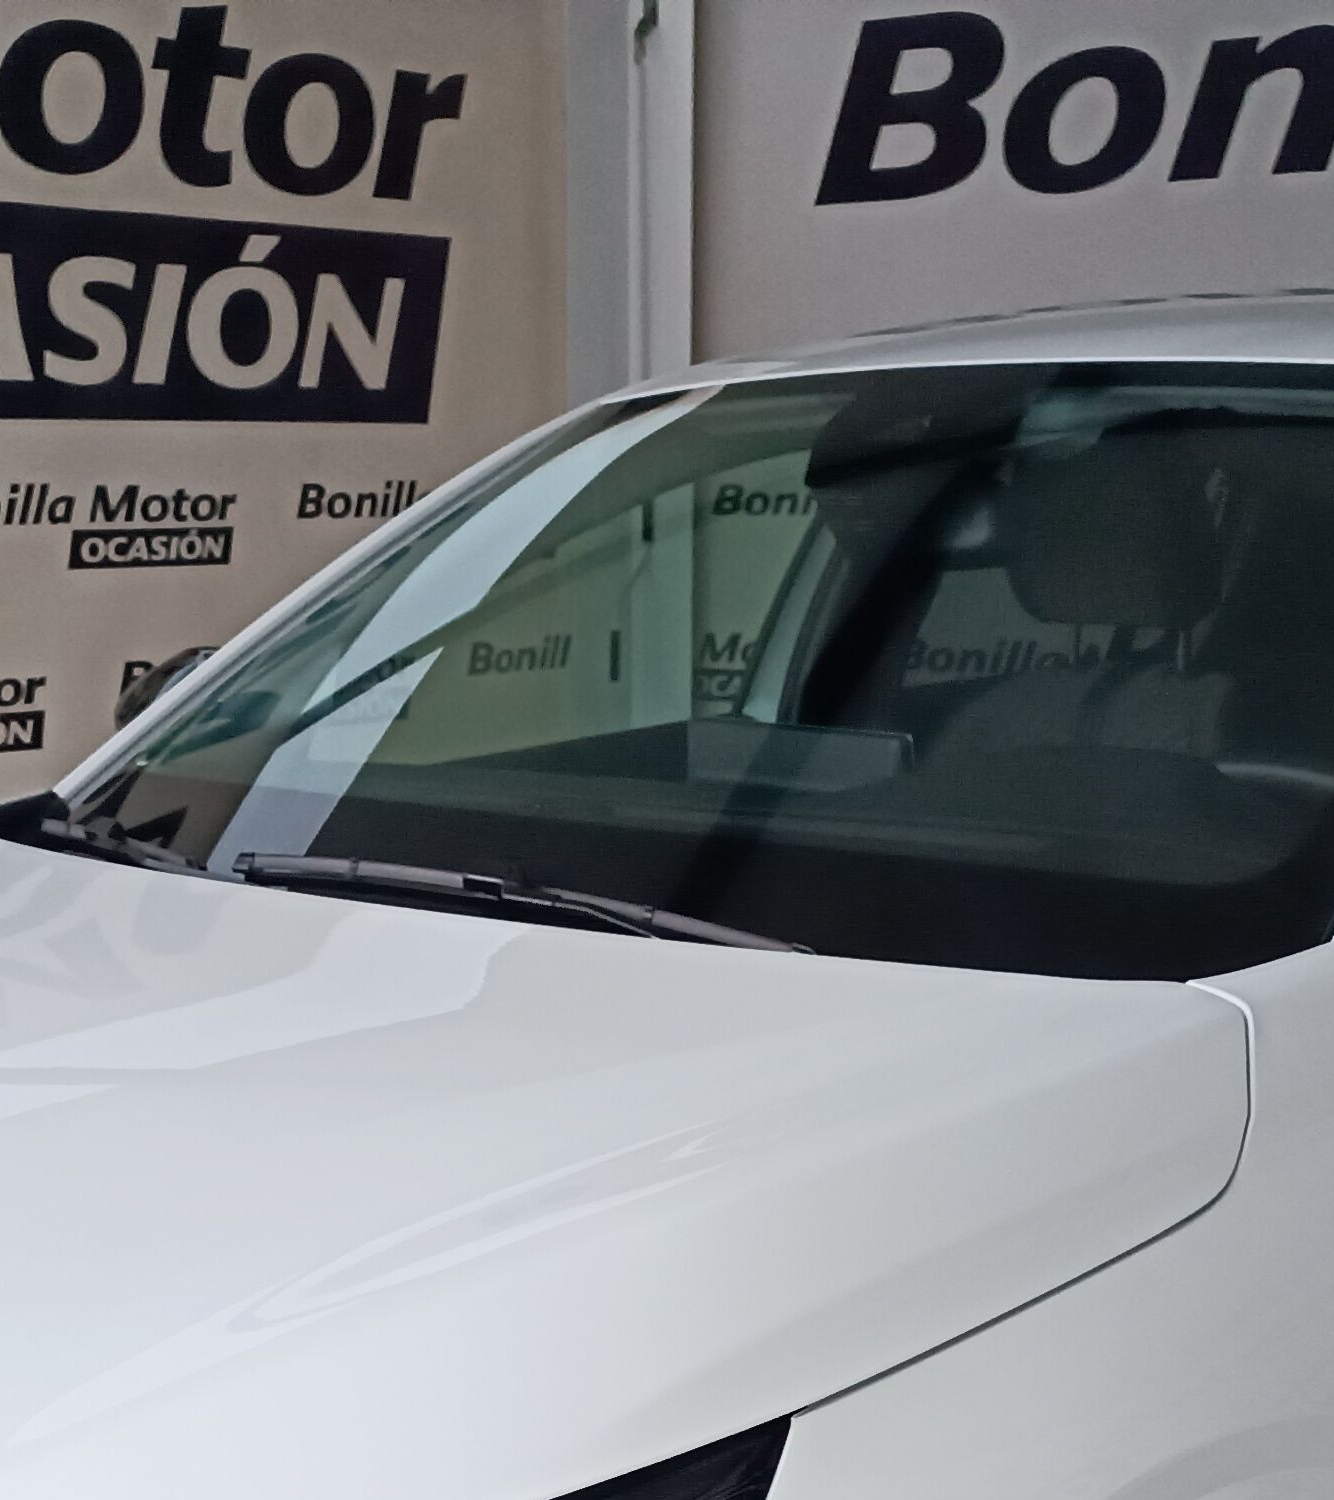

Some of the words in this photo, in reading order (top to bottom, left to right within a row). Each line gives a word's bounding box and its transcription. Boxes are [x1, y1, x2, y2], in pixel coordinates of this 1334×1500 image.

[89, 484, 237, 524] Motor
[297, 480, 431, 519] Bonill
[79, 531, 225, 566] OCASIÓN
